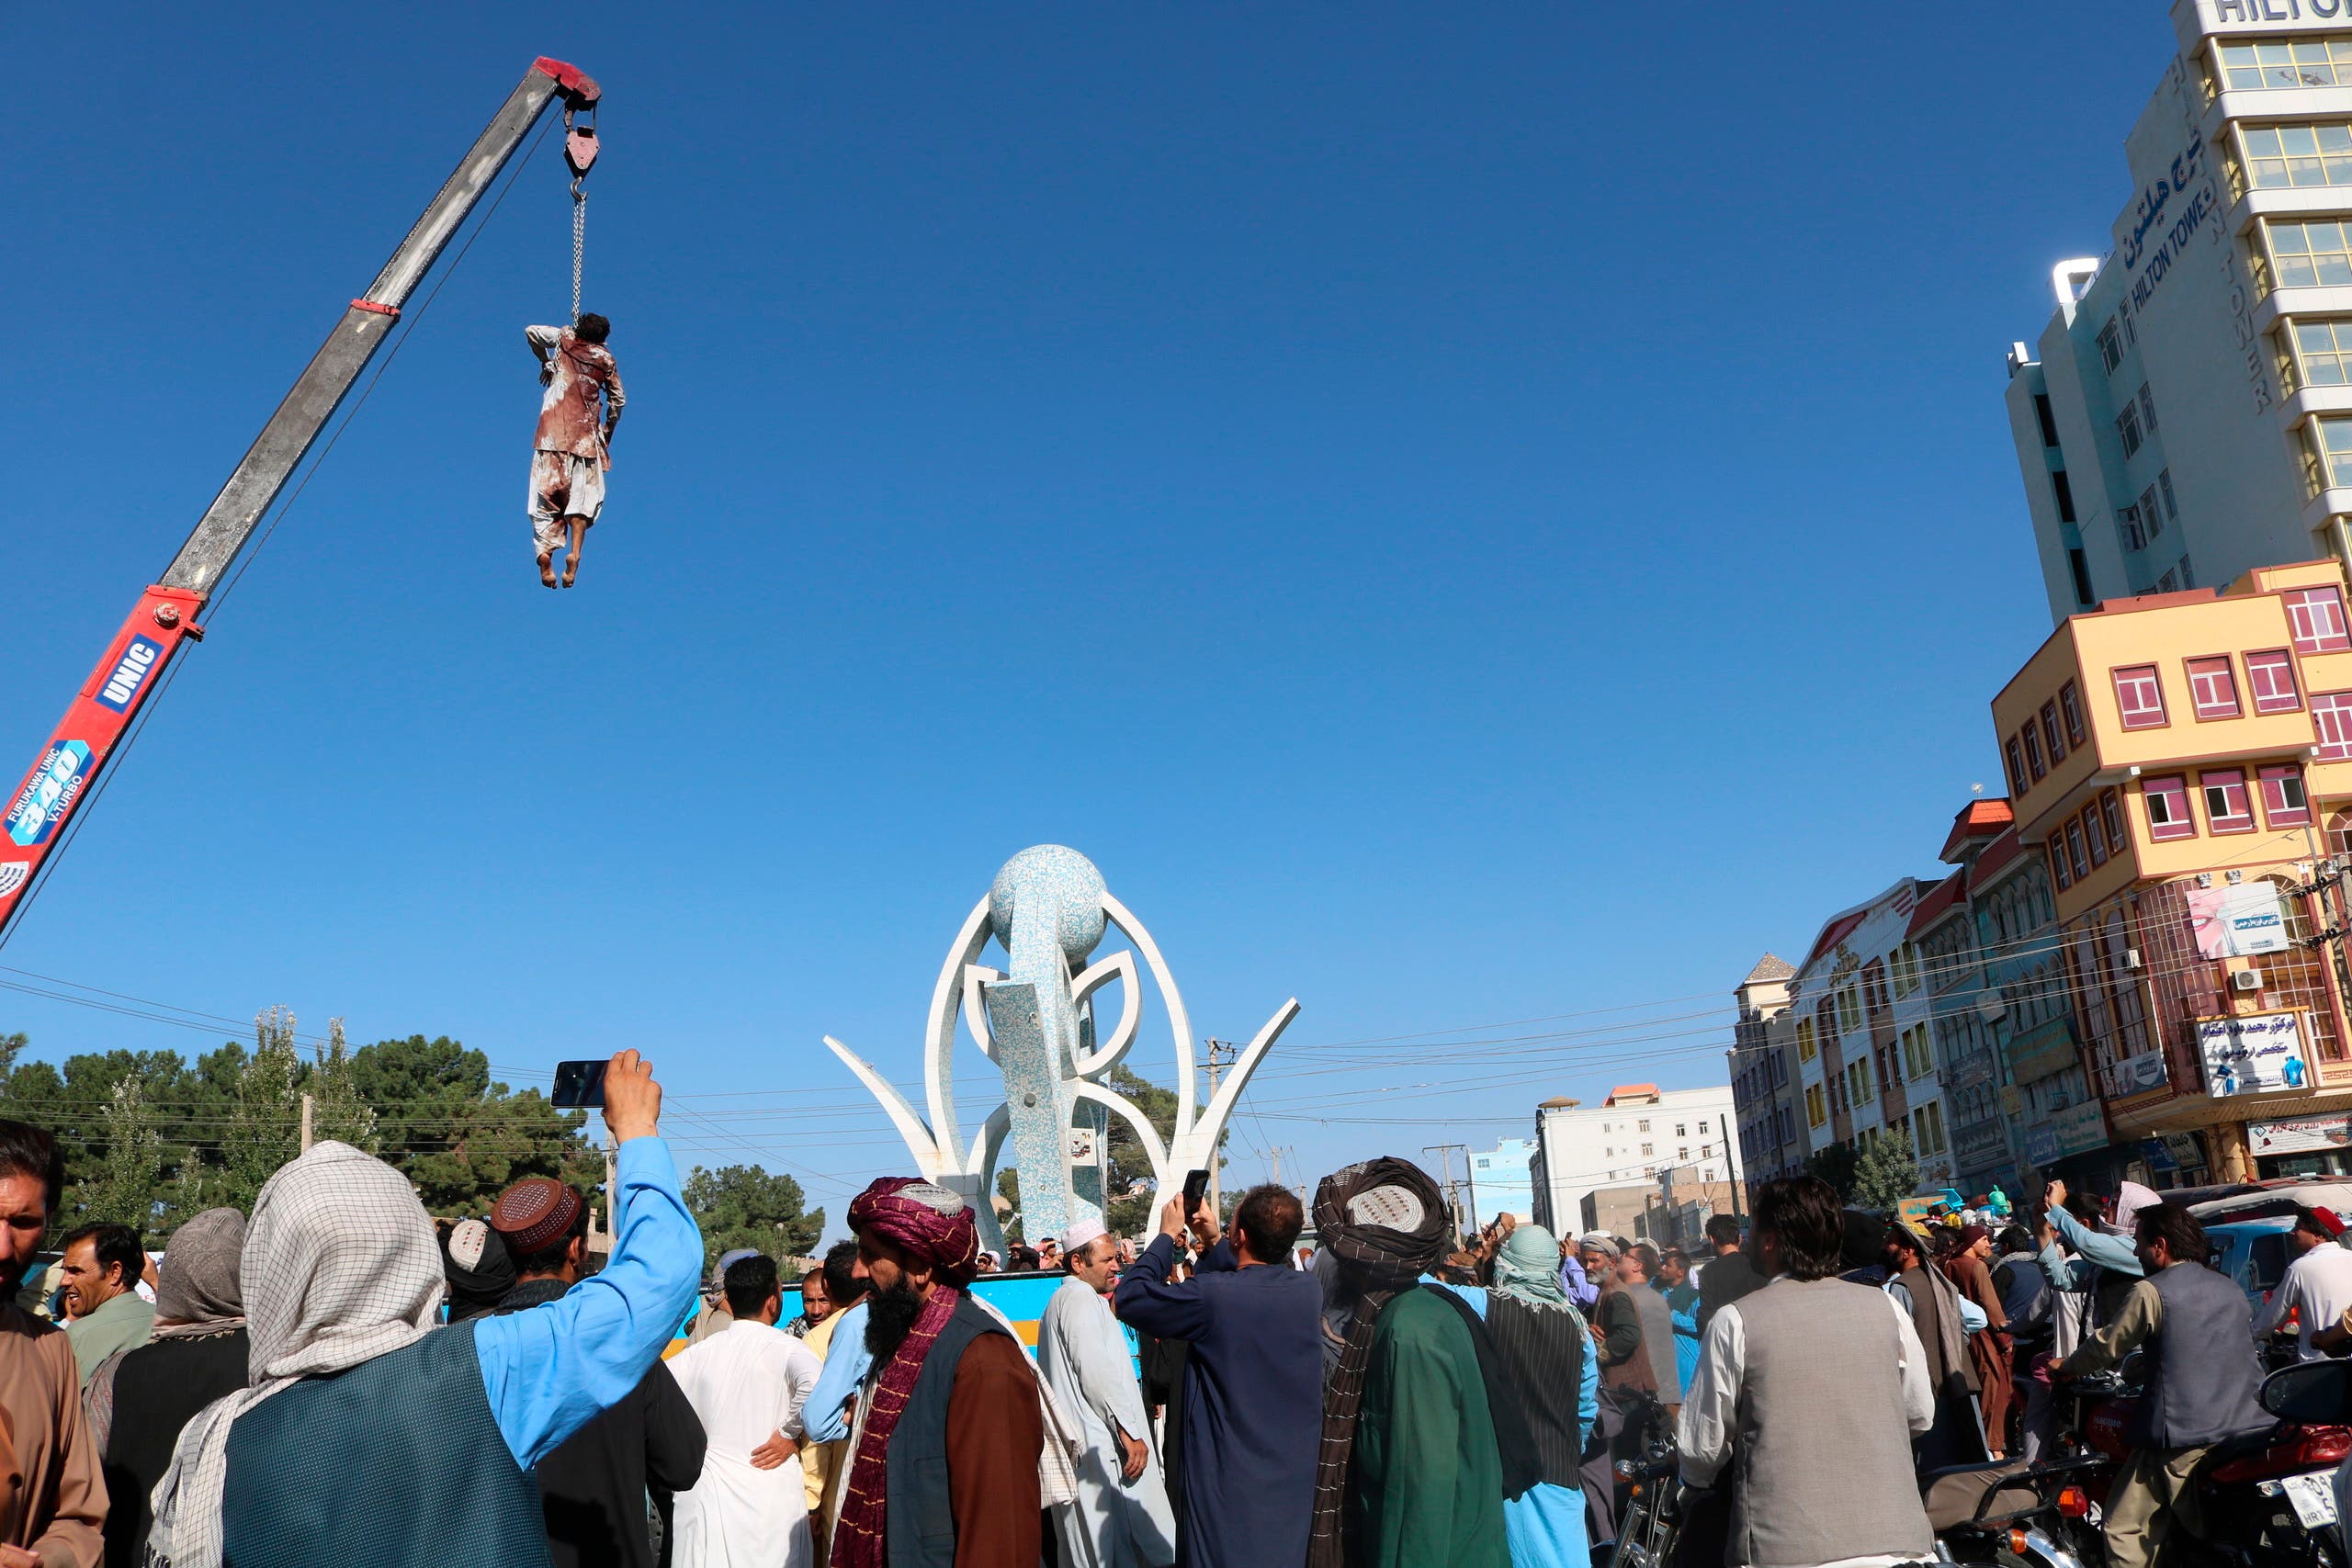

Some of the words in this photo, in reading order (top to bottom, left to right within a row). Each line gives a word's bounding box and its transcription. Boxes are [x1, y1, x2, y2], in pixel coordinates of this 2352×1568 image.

[2132, 243, 2172, 312] HILTON
[2220, 251, 2272, 415] TOWER
[103, 642, 155, 705] UNIC
[7, 772, 45, 822] FURUKAWA
[40, 748, 60, 772] UNIC
[18, 749, 79, 835] 340
[47, 775, 83, 822] V-TURBO
[2245, 1021, 2268, 1034] محمد
[2255, 1043, 2289, 1058] متخصص
